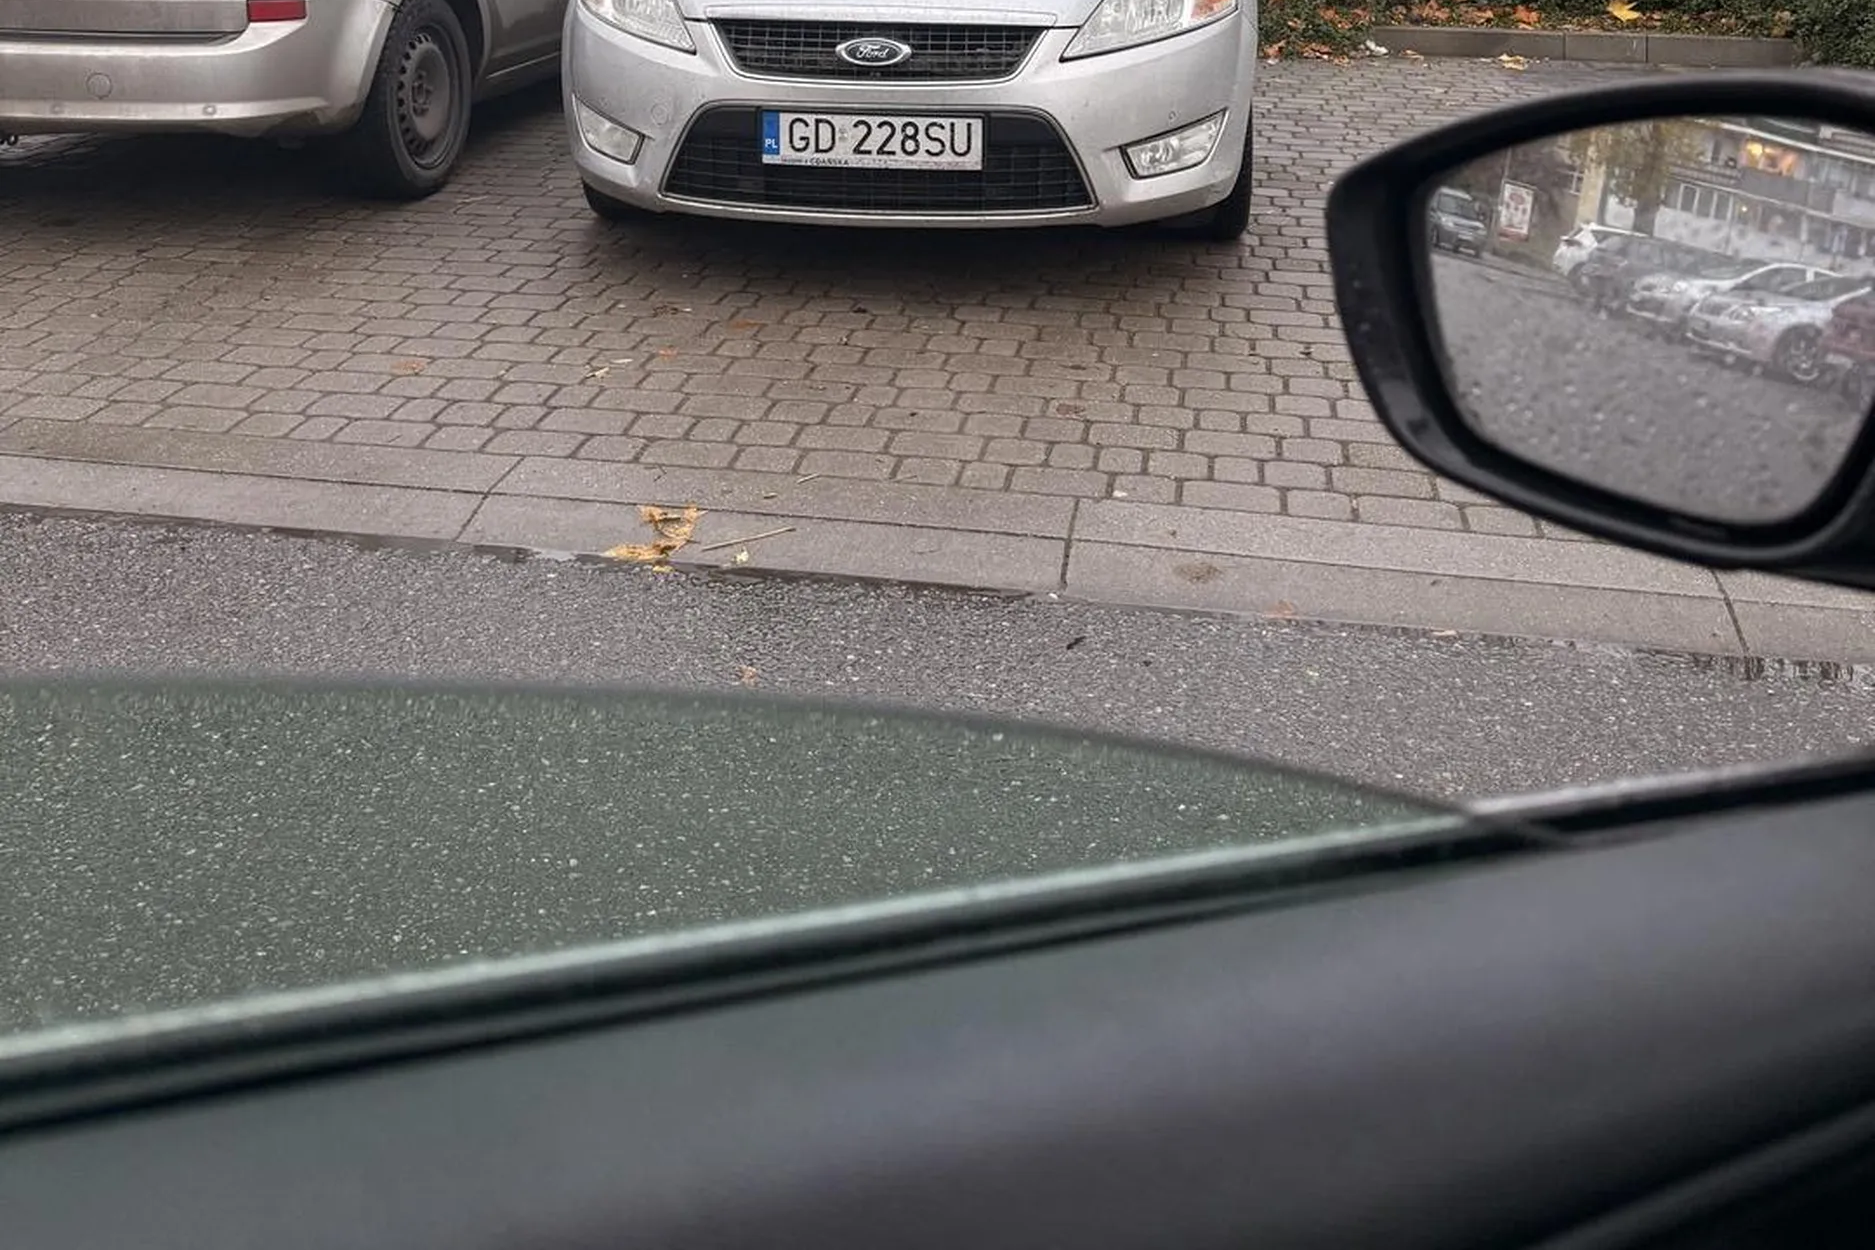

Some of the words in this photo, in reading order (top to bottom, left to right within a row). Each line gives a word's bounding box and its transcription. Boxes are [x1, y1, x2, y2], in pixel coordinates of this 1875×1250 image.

[856, 44, 889, 58] Ford
[765, 138, 778, 149] PL
[788, 117, 836, 153] GD
[852, 119, 972, 157] 228SU
